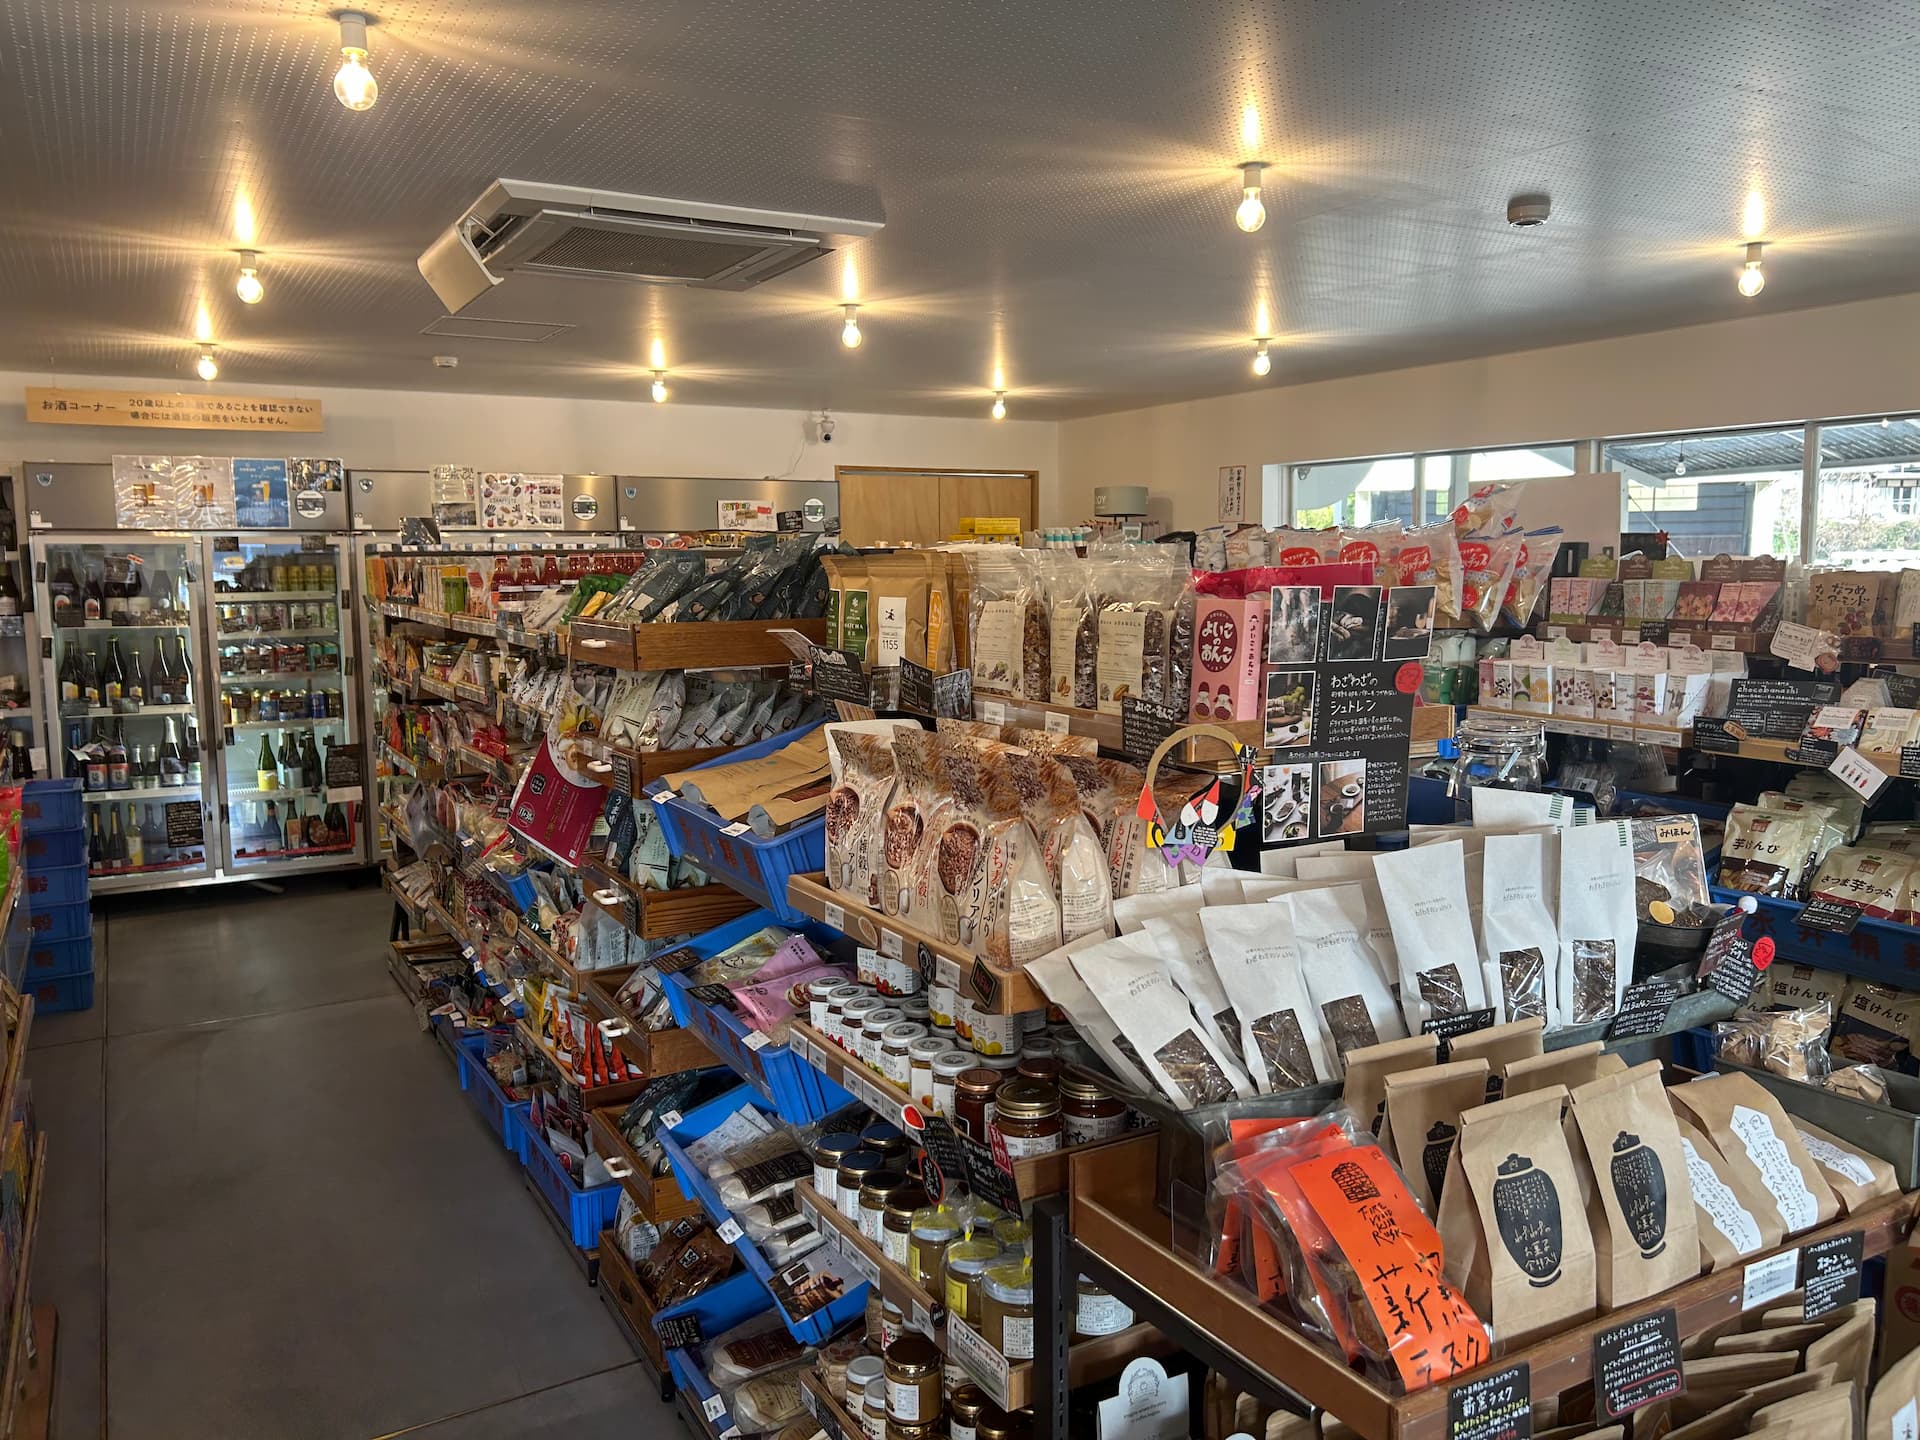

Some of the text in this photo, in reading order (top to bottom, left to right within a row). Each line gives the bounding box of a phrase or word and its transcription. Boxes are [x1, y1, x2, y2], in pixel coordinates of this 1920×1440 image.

[42, 400, 116, 411] お酒コーナー
[129, 398, 313, 413] 20歳以上のであることを確認できない
[1832, 583, 1867, 595] なつめ
[1828, 595, 1870, 606] アーモンド
[1202, 620, 1233, 639] よいこ
[881, 640, 899, 651] 1155
[1213, 637, 1221, 646] の
[1201, 644, 1233, 664] あんこ
[1330, 672, 1378, 688] わざわざの
[1330, 700, 1377, 716] シュトレン
[1660, 828, 1691, 838] みほん
